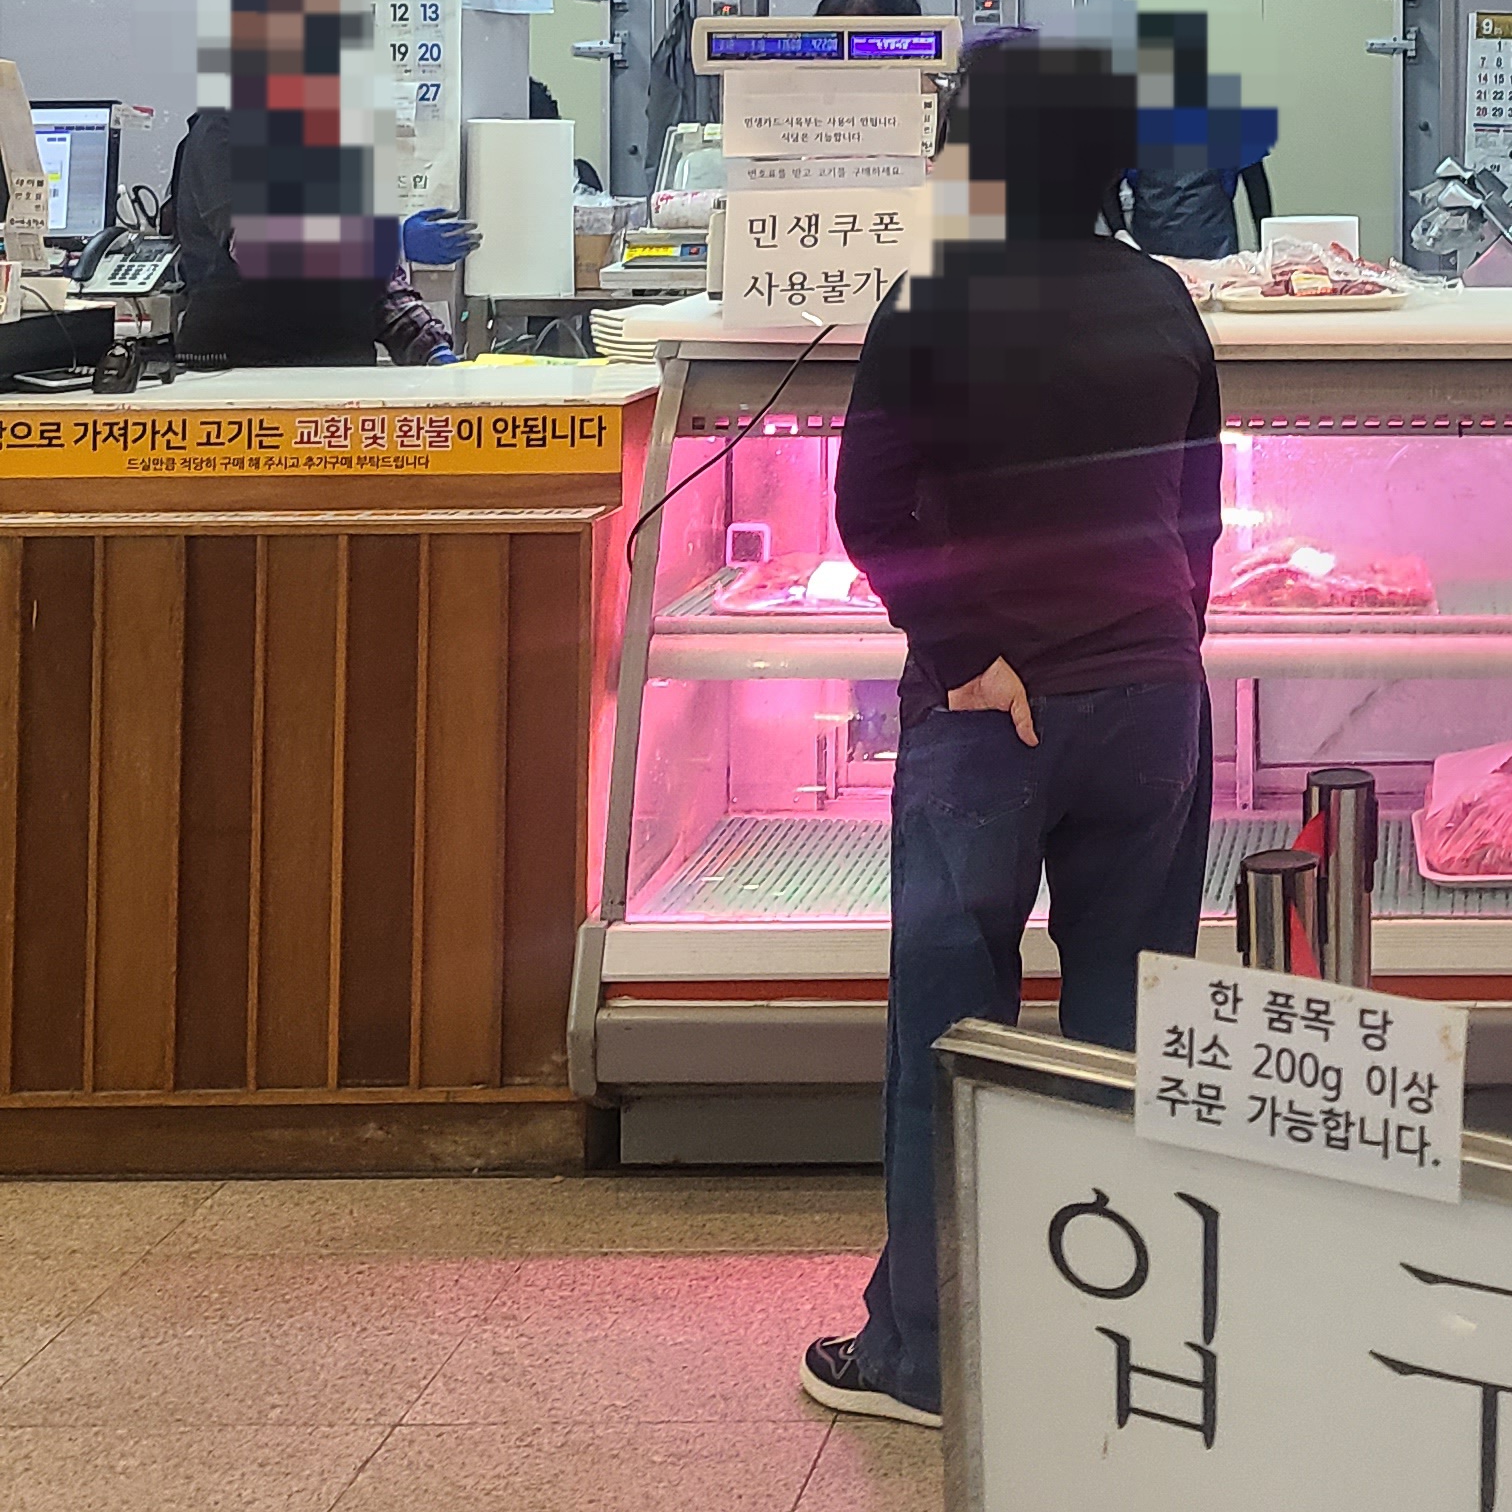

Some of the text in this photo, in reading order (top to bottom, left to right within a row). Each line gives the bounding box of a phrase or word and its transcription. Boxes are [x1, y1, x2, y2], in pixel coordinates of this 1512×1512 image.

[390, 3, 440, 22] 12 13
[1481, 18, 1494, 35] 9
[390, 43, 442, 62] 19 20
[1478, 73, 1488, 84] 14
[418, 83, 441, 102] 27
[1476, 90, 1487, 100] 21
[1492, 90, 1504, 101] 22
[748, 211, 904, 249] 민생쿠폰
[743, 267, 889, 307] 사용불가
[73, 418, 188, 451] 가져가신
[196, 417, 284, 450] 고기는
[293, 417, 351, 449] 교환
[360, 415, 387, 448] 및
[396, 415, 482, 449] 환불이
[492, 414, 607, 448] 안됩니다
[127, 456, 177, 471] 드실만큼
[356, 454, 430, 470] 부탁드립니다
[1208, 980, 1393, 1054] 한 품목 당
[1162, 1024, 1440, 1117] 최소 200g 이상
[1155, 1074, 1443, 1169] 주문 가능합니다.
